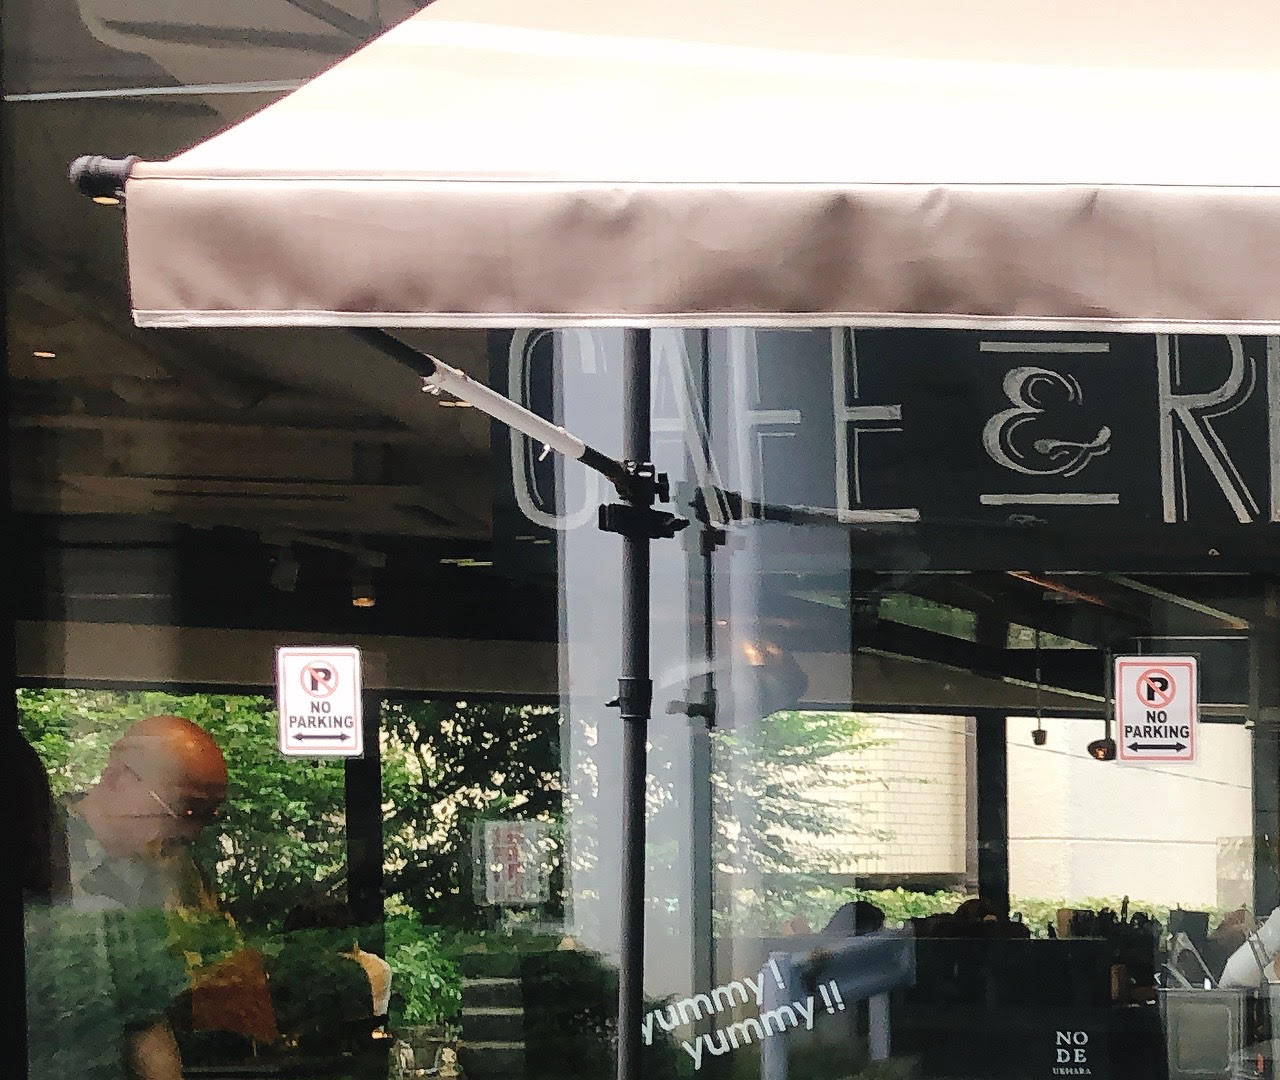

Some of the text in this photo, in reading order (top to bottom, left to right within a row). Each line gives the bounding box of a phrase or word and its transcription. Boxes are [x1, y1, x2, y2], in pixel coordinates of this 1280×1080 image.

[508, 327, 920, 531] CAFE
[310, 701, 331, 713] NO
[289, 715, 354, 728] PARKING
[1146, 710, 1168, 723] NO
[1124, 725, 1190, 738] PARKING
[1055, 1030, 1089, 1046] NO
[1056, 1048, 1087, 1063] DE
[1052, 1067, 1092, 1075] UEHARA
